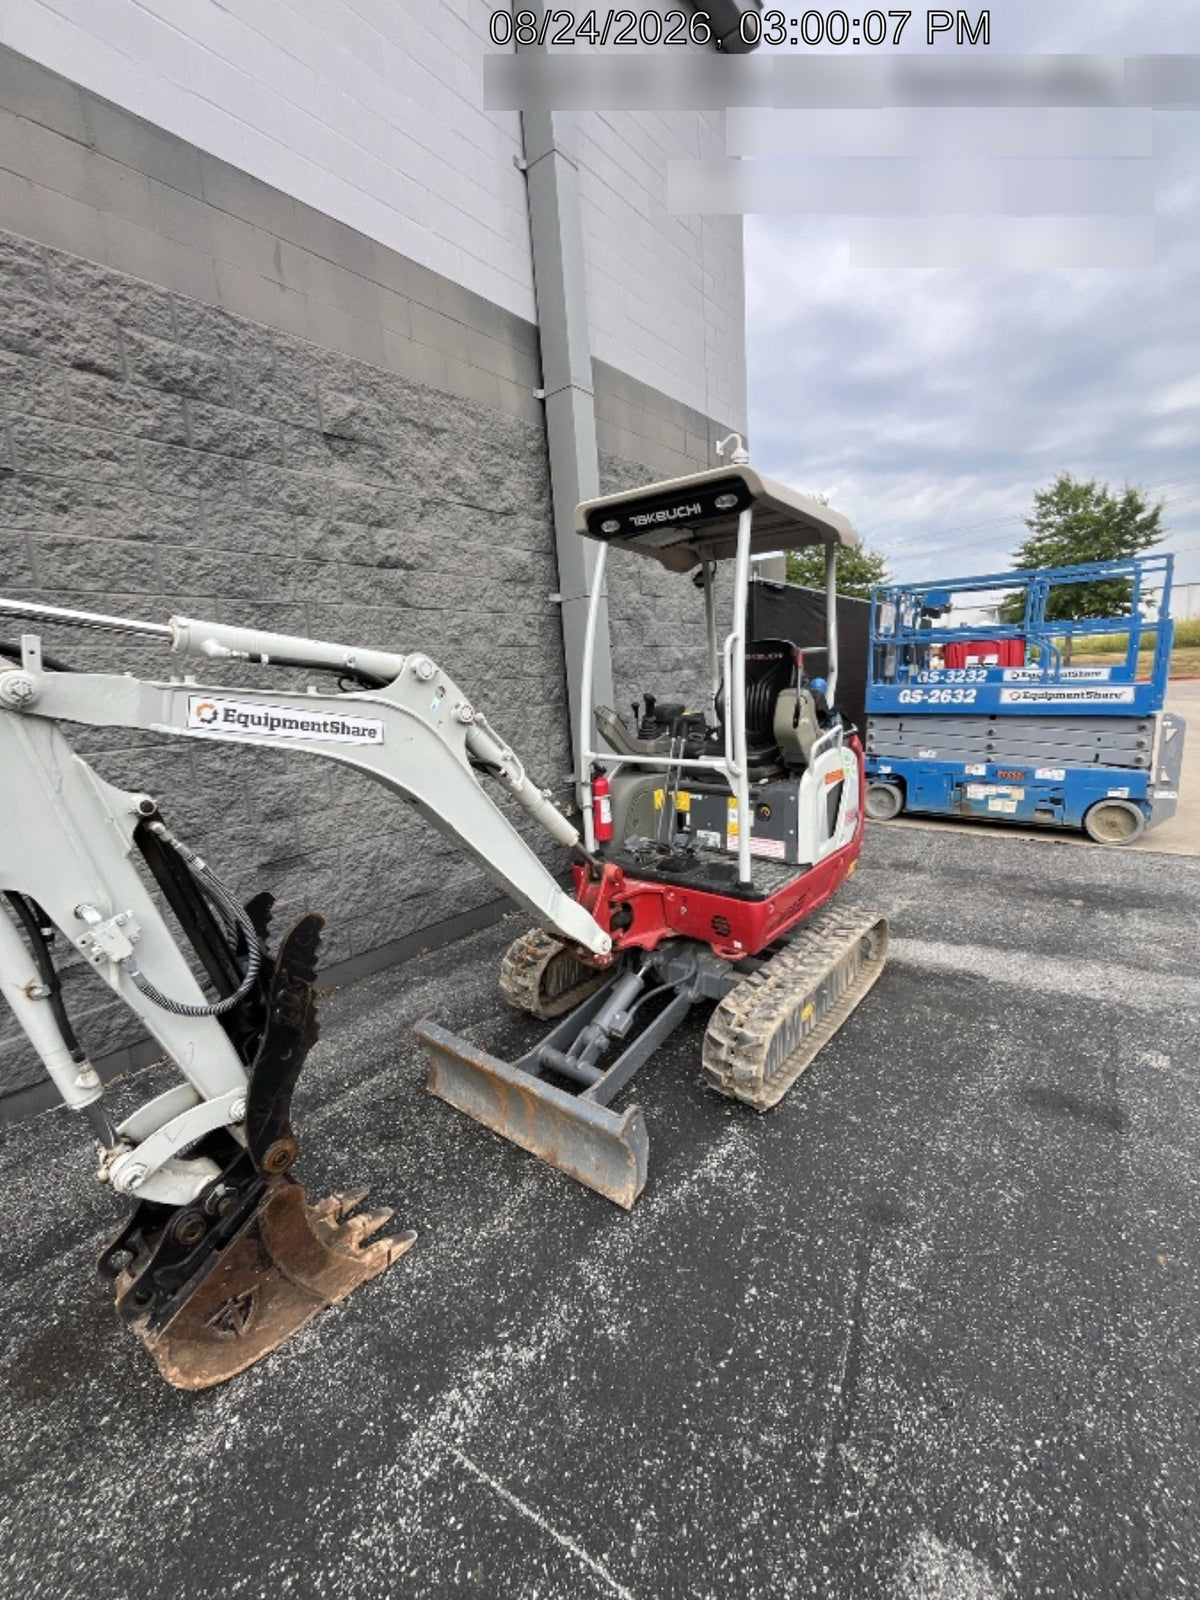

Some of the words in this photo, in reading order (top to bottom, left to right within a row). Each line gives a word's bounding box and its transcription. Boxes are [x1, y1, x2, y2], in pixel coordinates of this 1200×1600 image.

[899, 689, 977, 703] GS-2632
[1022, 690, 1123, 701] EquipmentShare
[223, 707, 378, 738] EquipmentShare
